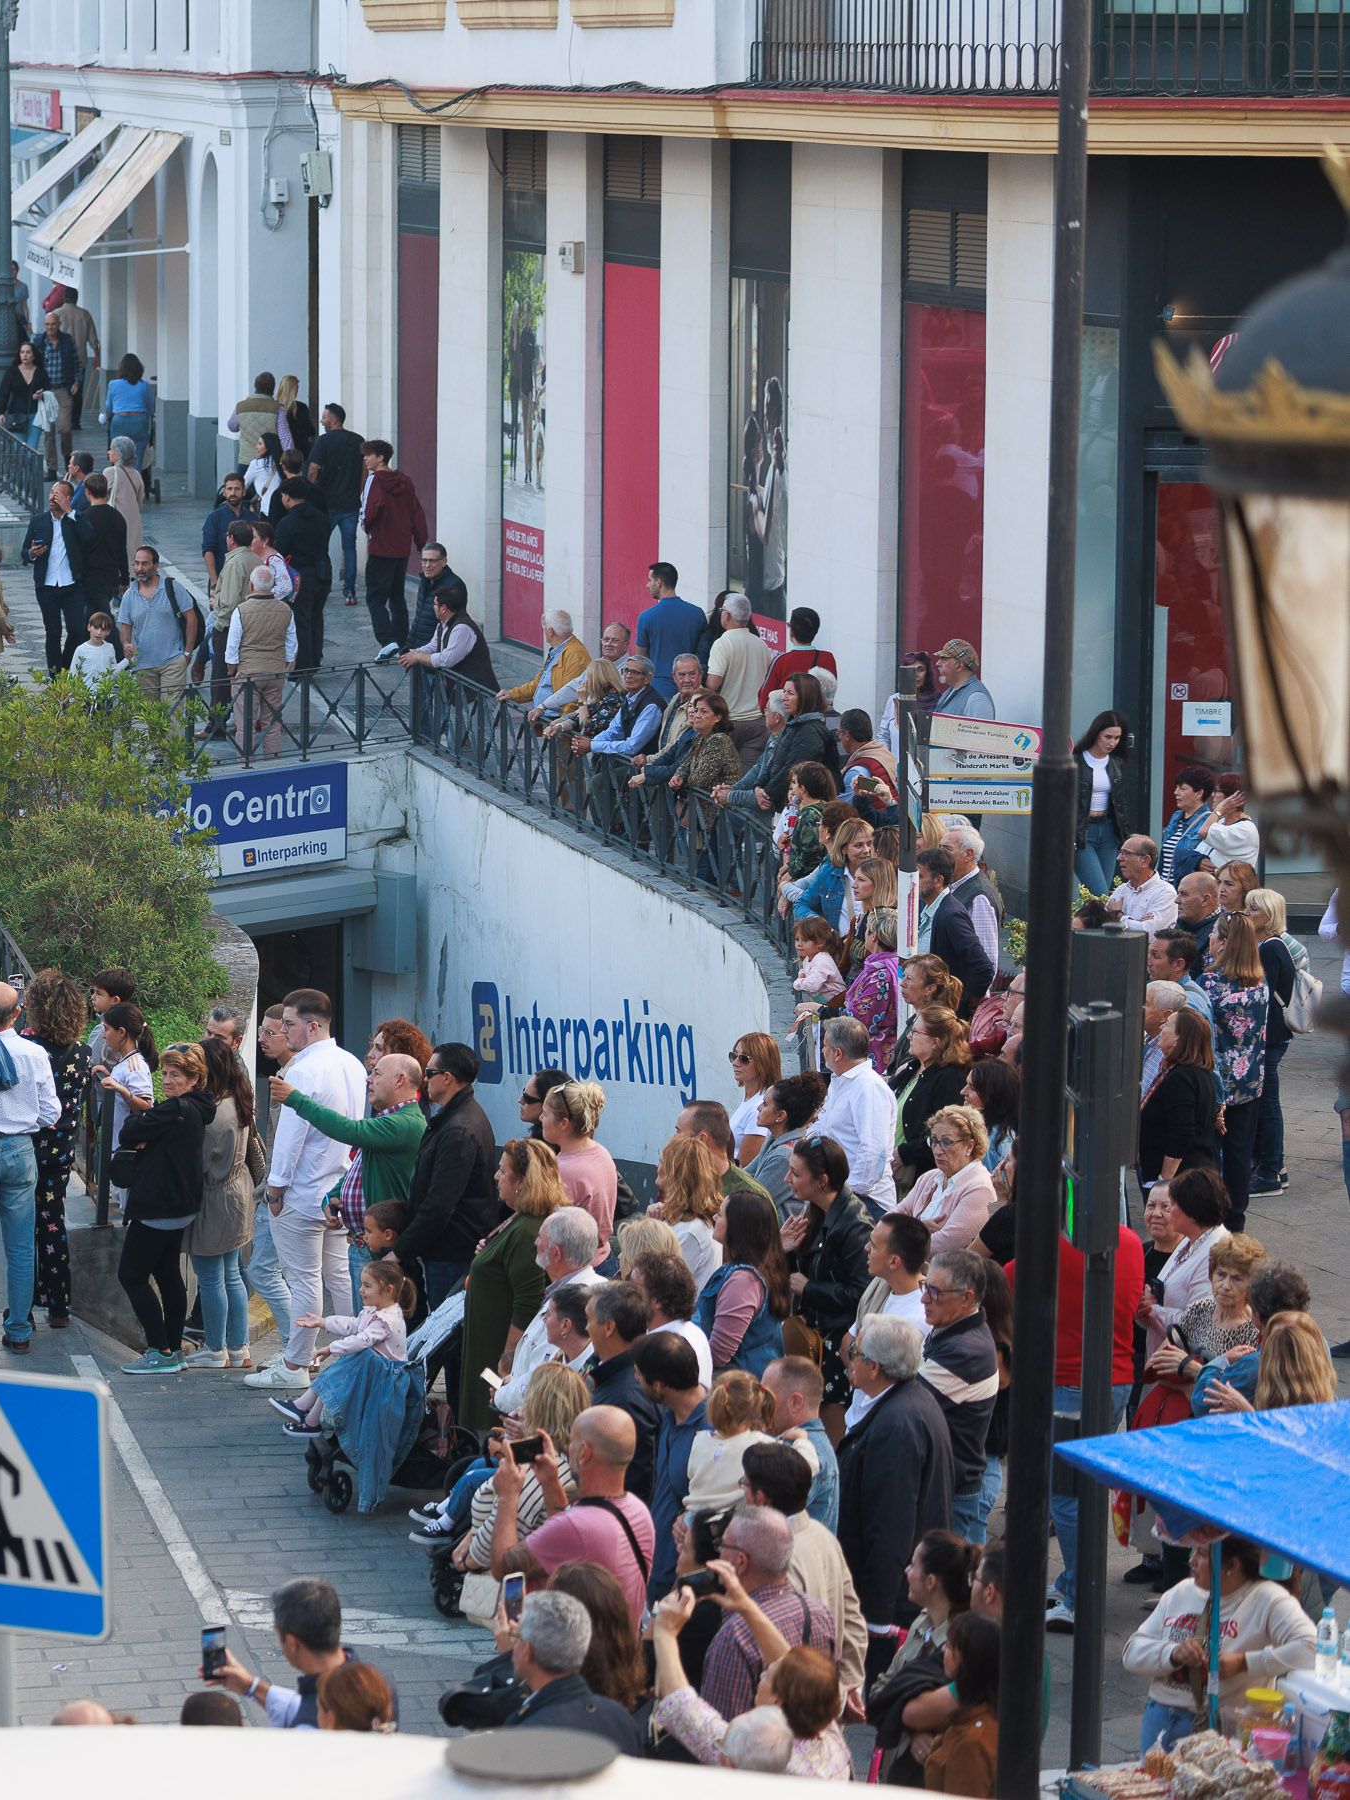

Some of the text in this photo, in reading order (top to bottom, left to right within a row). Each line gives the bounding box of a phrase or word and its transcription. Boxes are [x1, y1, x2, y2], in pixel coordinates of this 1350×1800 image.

[767, 628, 778, 644] HAS
[257, 840, 327, 864] Interparking
[505, 996, 696, 1106] Interparking
